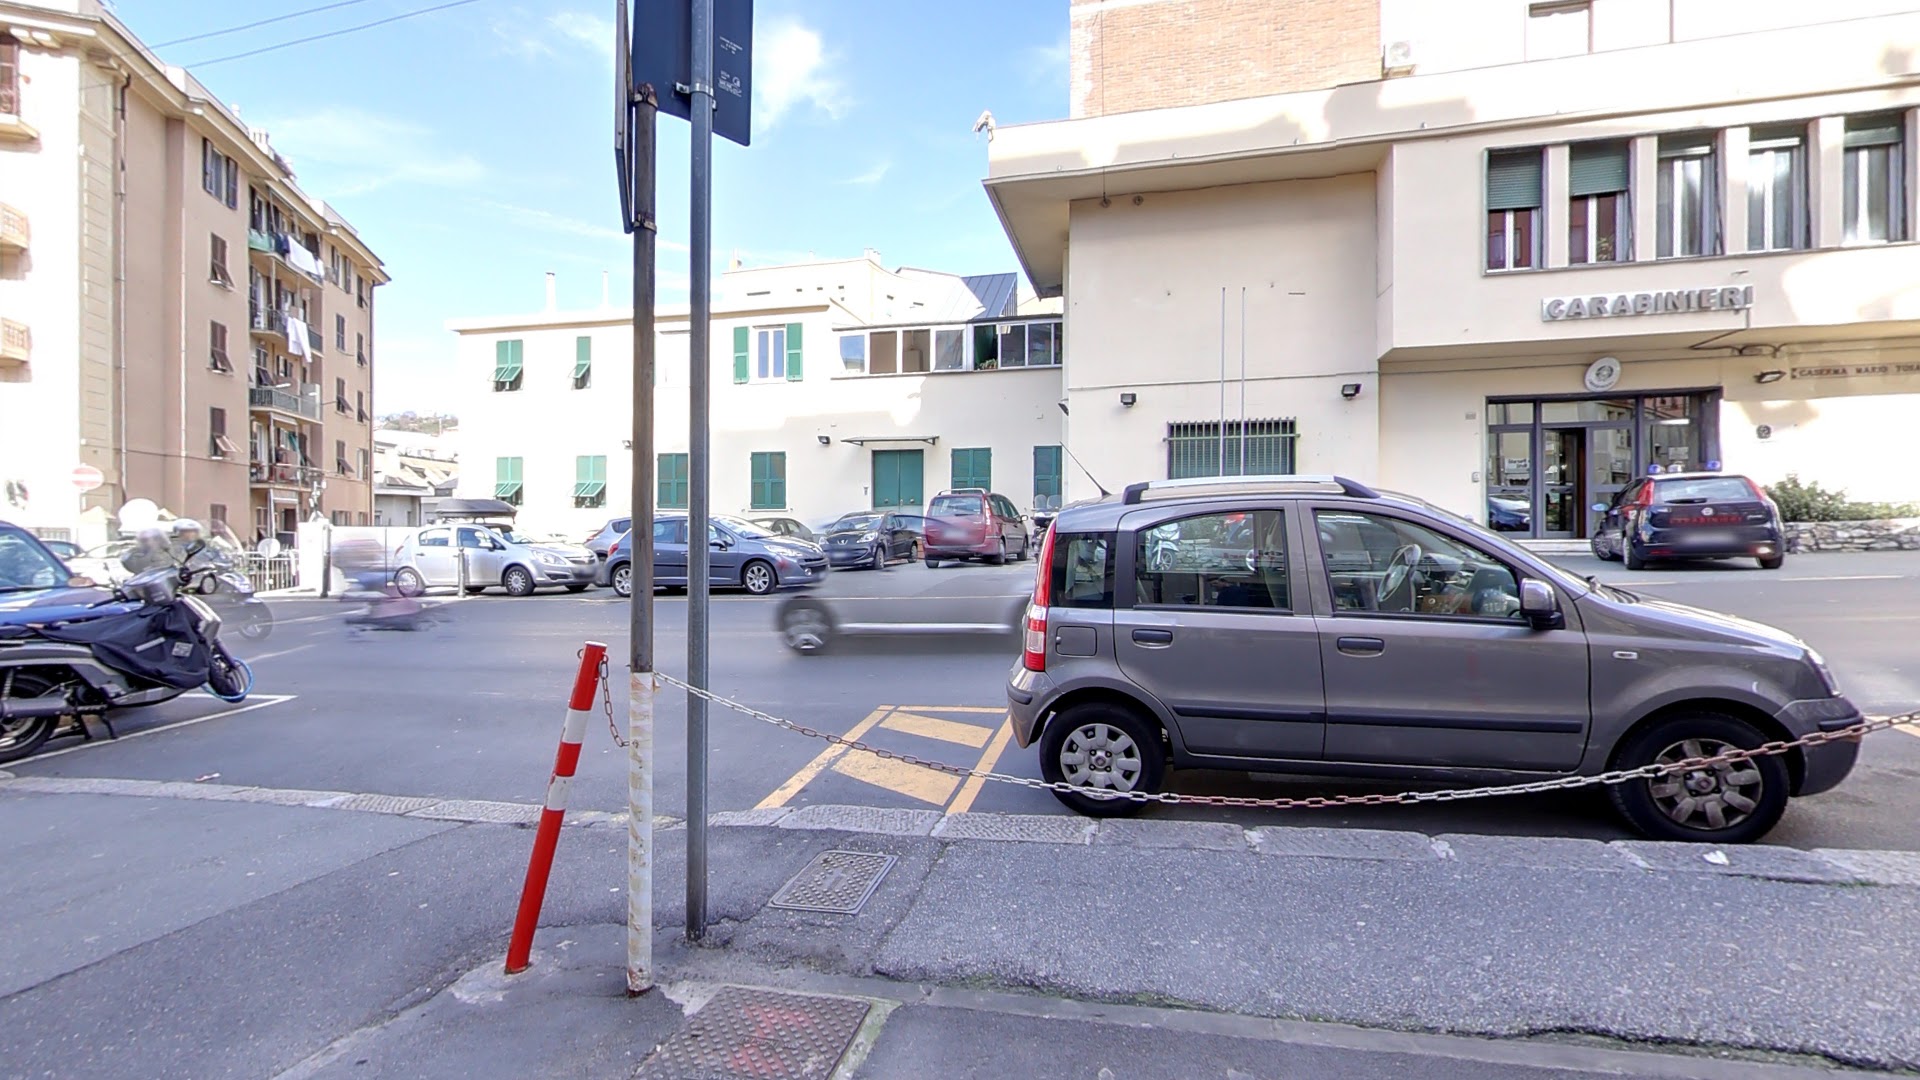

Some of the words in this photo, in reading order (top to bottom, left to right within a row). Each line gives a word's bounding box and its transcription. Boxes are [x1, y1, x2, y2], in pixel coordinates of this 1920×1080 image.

[1546, 285, 1753, 319] CARABINIERI
[1799, 367, 1848, 377] CASERMA
[1855, 365, 1889, 374] MARIO
